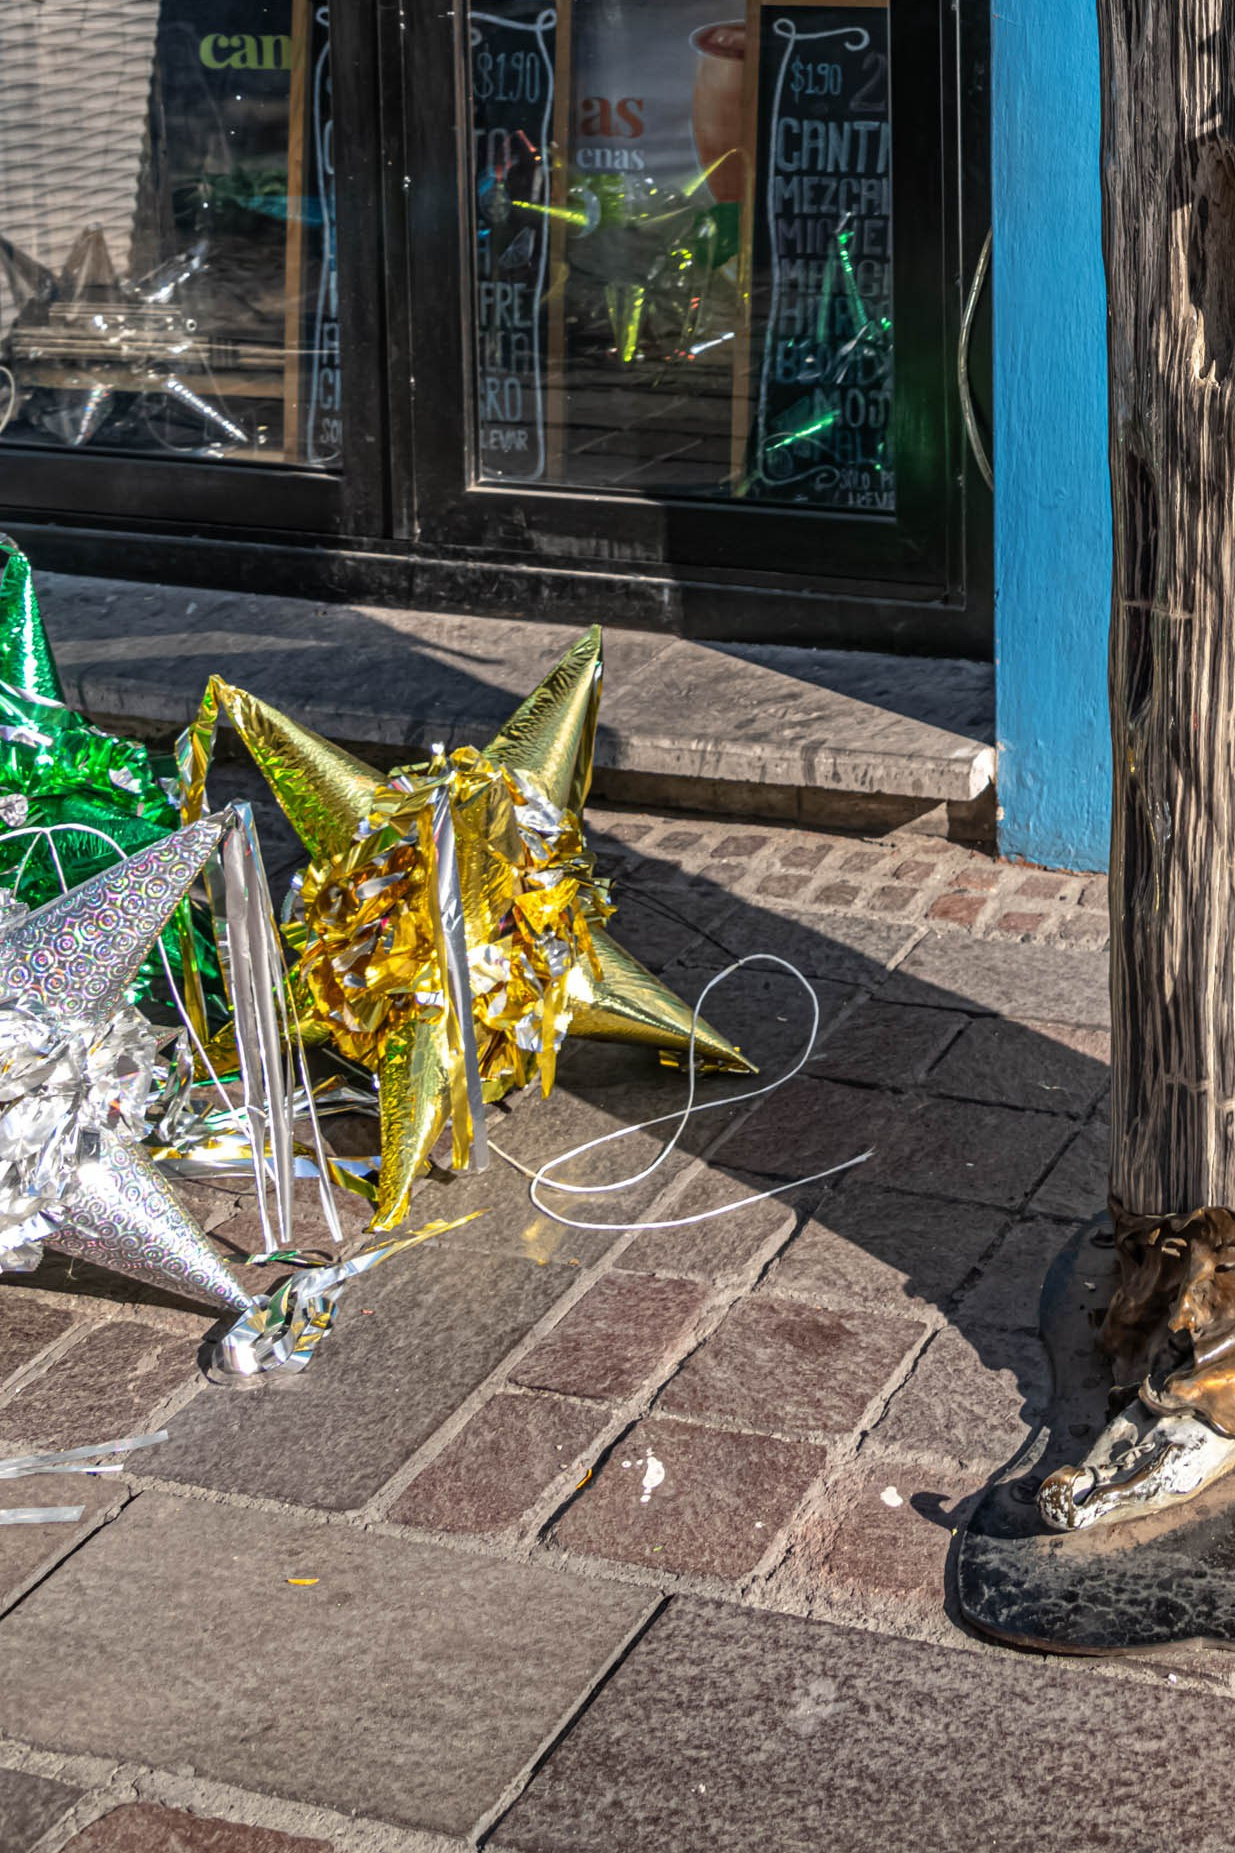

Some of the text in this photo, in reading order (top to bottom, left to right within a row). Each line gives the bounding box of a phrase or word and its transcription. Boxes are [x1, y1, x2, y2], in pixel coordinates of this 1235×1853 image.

[790, 54, 842, 105] $190
[581, 96, 644, 139] as
[575, 147, 646, 171] enas
